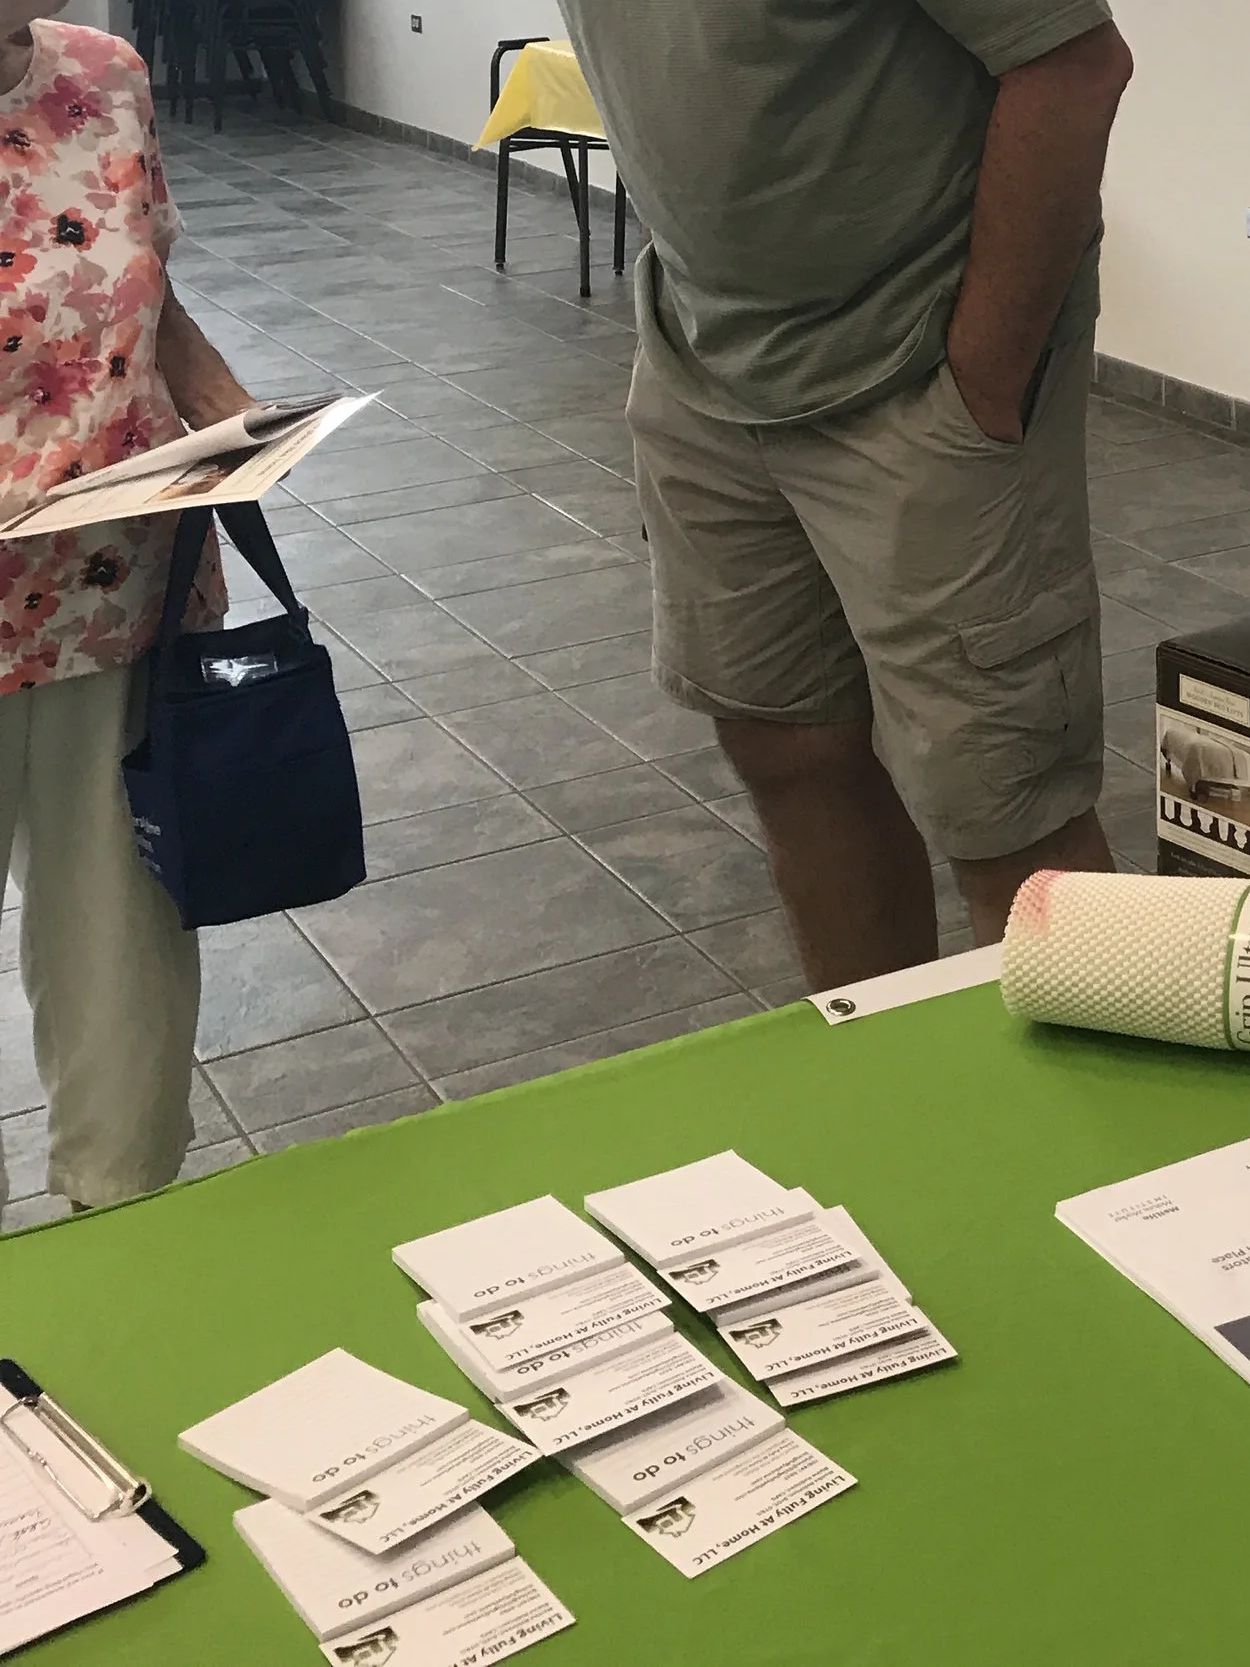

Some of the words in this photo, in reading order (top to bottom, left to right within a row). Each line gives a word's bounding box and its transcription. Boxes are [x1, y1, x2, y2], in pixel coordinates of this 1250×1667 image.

[717, 1205, 788, 1232] things
[1142, 1206, 1180, 1221] MetLife
[668, 1234, 698, 1248] do
[697, 1227, 719, 1238] to
[813, 1250, 855, 1267] Living
[1210, 1246, 1245, 1264] Place
[524, 1249, 597, 1282] things
[782, 1263, 817, 1277] Fully
[503, 1276, 526, 1289] to
[769, 1274, 786, 1282] At
[471, 1284, 502, 1300] do
[726, 1279, 771, 1296] Home,
[621, 1297, 662, 1316] Living
[703, 1293, 729, 1304] LLC
[588, 1312, 623, 1329] Fully
[877, 1318, 919, 1335] Living
[569, 1319, 644, 1355] things
[573, 1325, 590, 1334] At
[845, 1330, 881, 1345] Fully
[528, 1331, 573, 1351] Home,
[831, 1341, 848, 1350] At
[503, 1348, 529, 1360] LLC
[547, 1349, 571, 1363] to
[787, 1346, 833, 1363] Home,
[906, 1346, 948, 1364] Living
[513, 1359, 547, 1377] do
[762, 1359, 790, 1371] LLC
[874, 1359, 908, 1373] Fully
[671, 1371, 715, 1392] Living
[814, 1373, 859, 1391] Home,
[857, 1369, 875, 1379] At
[638, 1388, 675, 1407] Fully
[788, 1386, 815, 1399] LLC
[623, 1404, 641, 1414] At
[577, 1411, 624, 1433] Home,
[361, 1410, 436, 1458] things
[550, 1430, 580, 1445] LLC
[680, 1412, 756, 1458] things
[341, 1451, 367, 1468] to
[490, 1449, 533, 1476] Living
[660, 1450, 687, 1468] to
[310, 1464, 343, 1486] do
[630, 1462, 664, 1485] do
[460, 1473, 494, 1495] Fully
[803, 1474, 846, 1500] Living
[447, 1493, 463, 1504] At
[772, 1496, 808, 1518] Fully
[401, 1500, 447, 1530] Home,
[758, 1514, 777, 1528] At
[378, 1526, 405, 1544] LLC
[714, 1523, 761, 1551] Home,
[401, 1540, 483, 1582] things
[690, 1548, 719, 1565] LLC
[375, 1577, 400, 1594] to
[337, 1590, 369, 1610] do
[515, 1612, 563, 1637] Living
[481, 1636, 517, 1664] Fully
